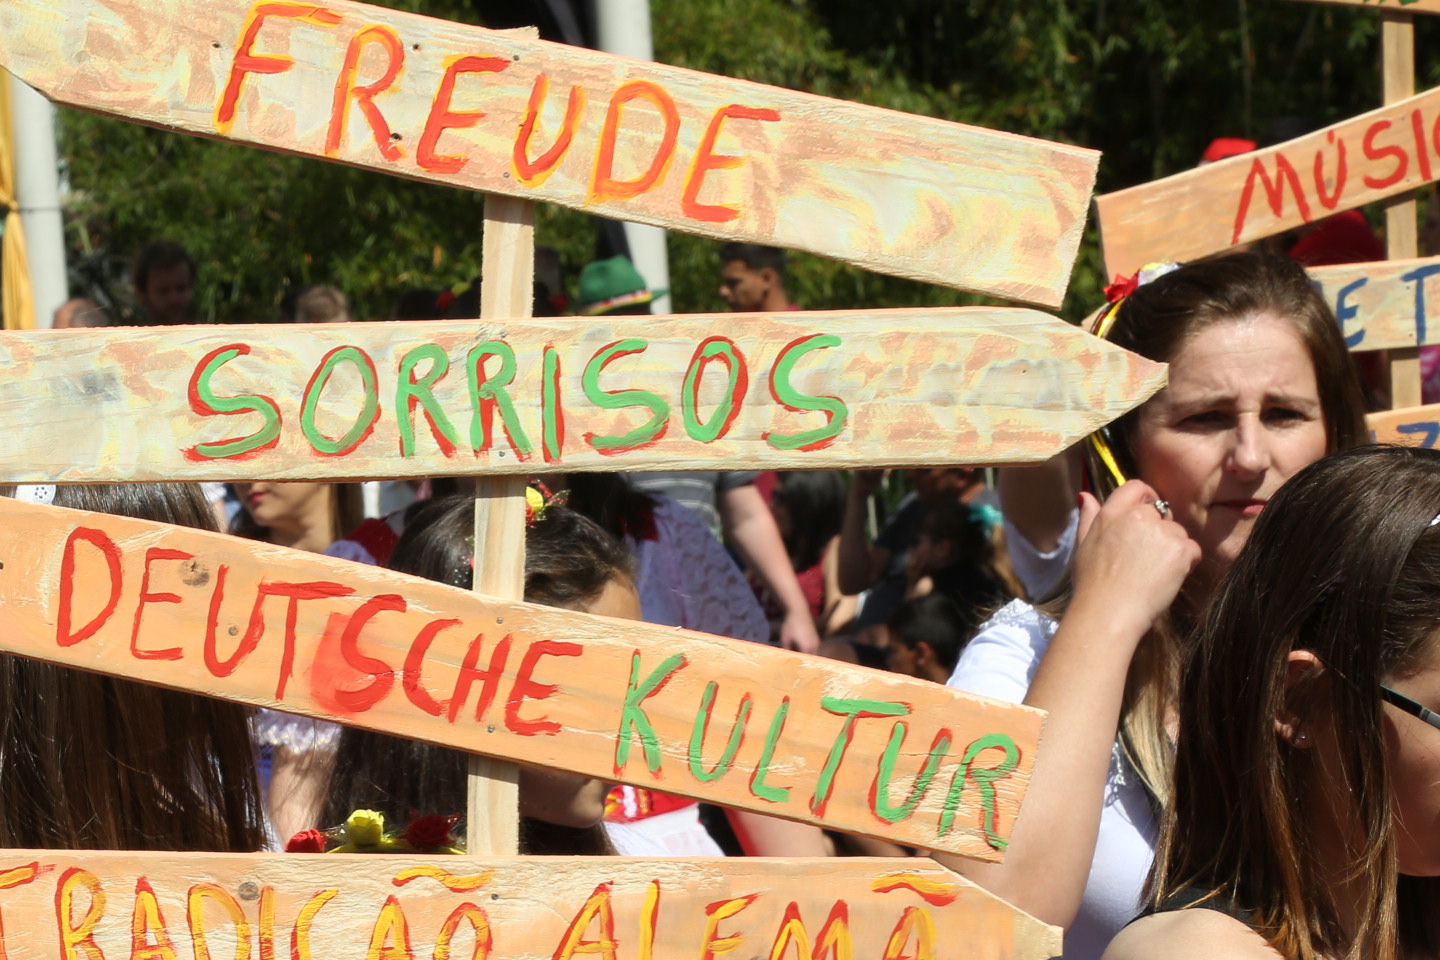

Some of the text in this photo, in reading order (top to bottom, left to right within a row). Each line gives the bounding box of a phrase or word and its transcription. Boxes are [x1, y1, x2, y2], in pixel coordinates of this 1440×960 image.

[212, 1, 781, 222] FREUDE
[1231, 109, 1440, 245] MÚSI
[181, 333, 849, 463] SORRISOS
[57, 527, 1023, 851] DEUTSCHE KULTUR
